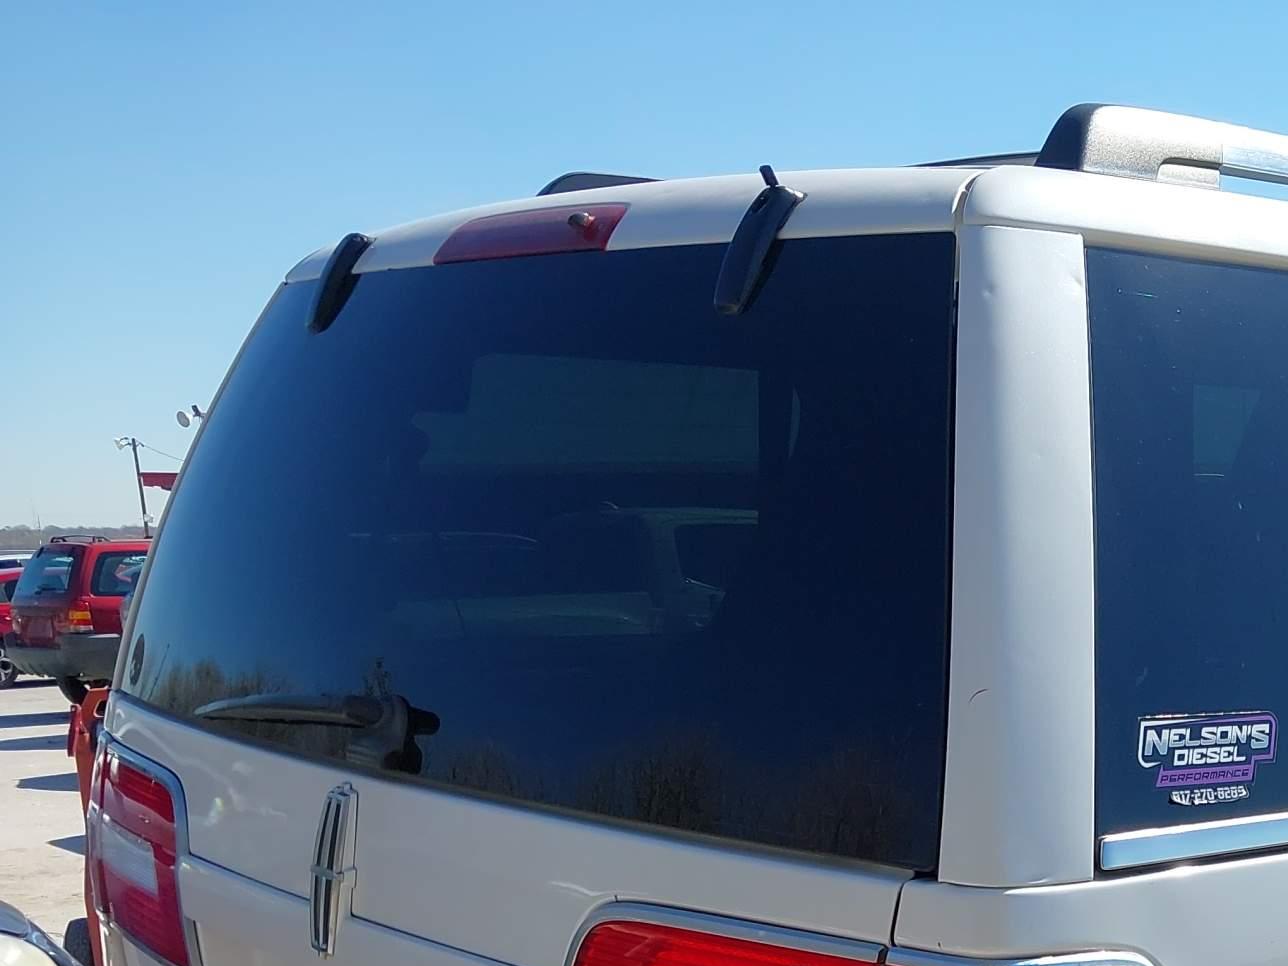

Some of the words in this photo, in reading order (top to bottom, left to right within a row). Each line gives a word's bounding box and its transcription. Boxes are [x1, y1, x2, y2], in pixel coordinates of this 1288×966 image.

[1143, 722, 1271, 756] NELSON'S
[1172, 746, 1247, 767] DIESEL
[1159, 767, 1250, 785] PERFORMANCE
